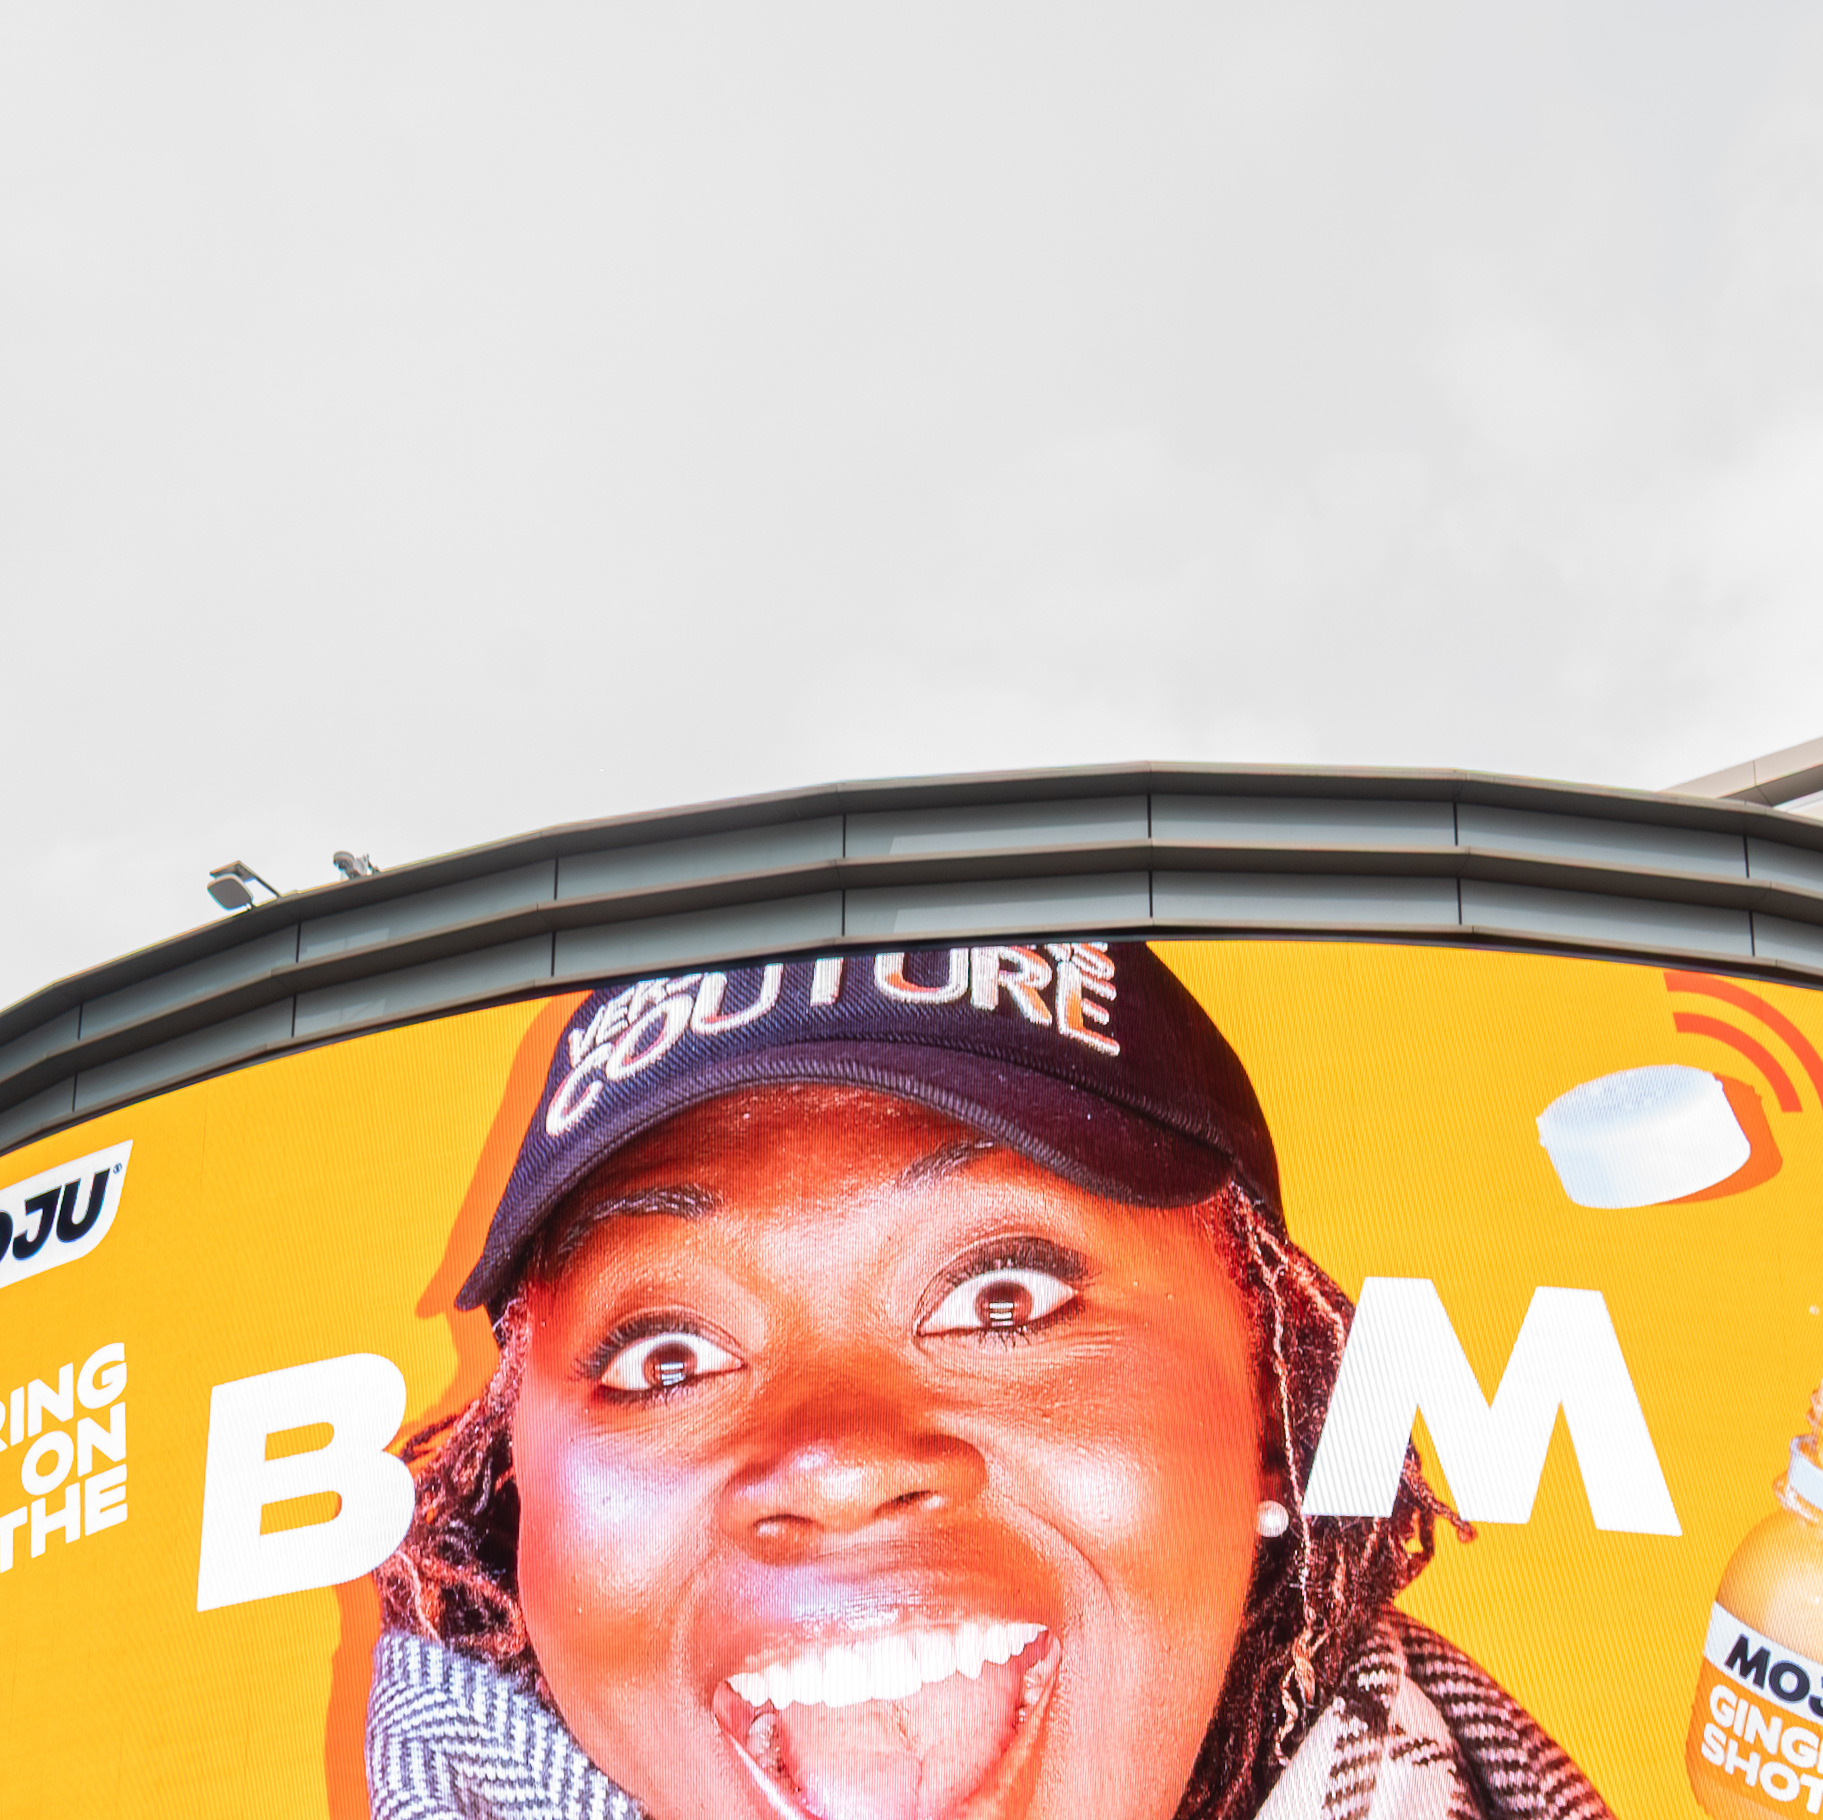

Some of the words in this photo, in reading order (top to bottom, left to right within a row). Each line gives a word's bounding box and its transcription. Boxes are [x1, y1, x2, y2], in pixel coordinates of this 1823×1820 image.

[21, 1401, 126, 1496] ON
[196, 1352, 415, 1612] B
[1302, 1276, 1682, 1536] M
